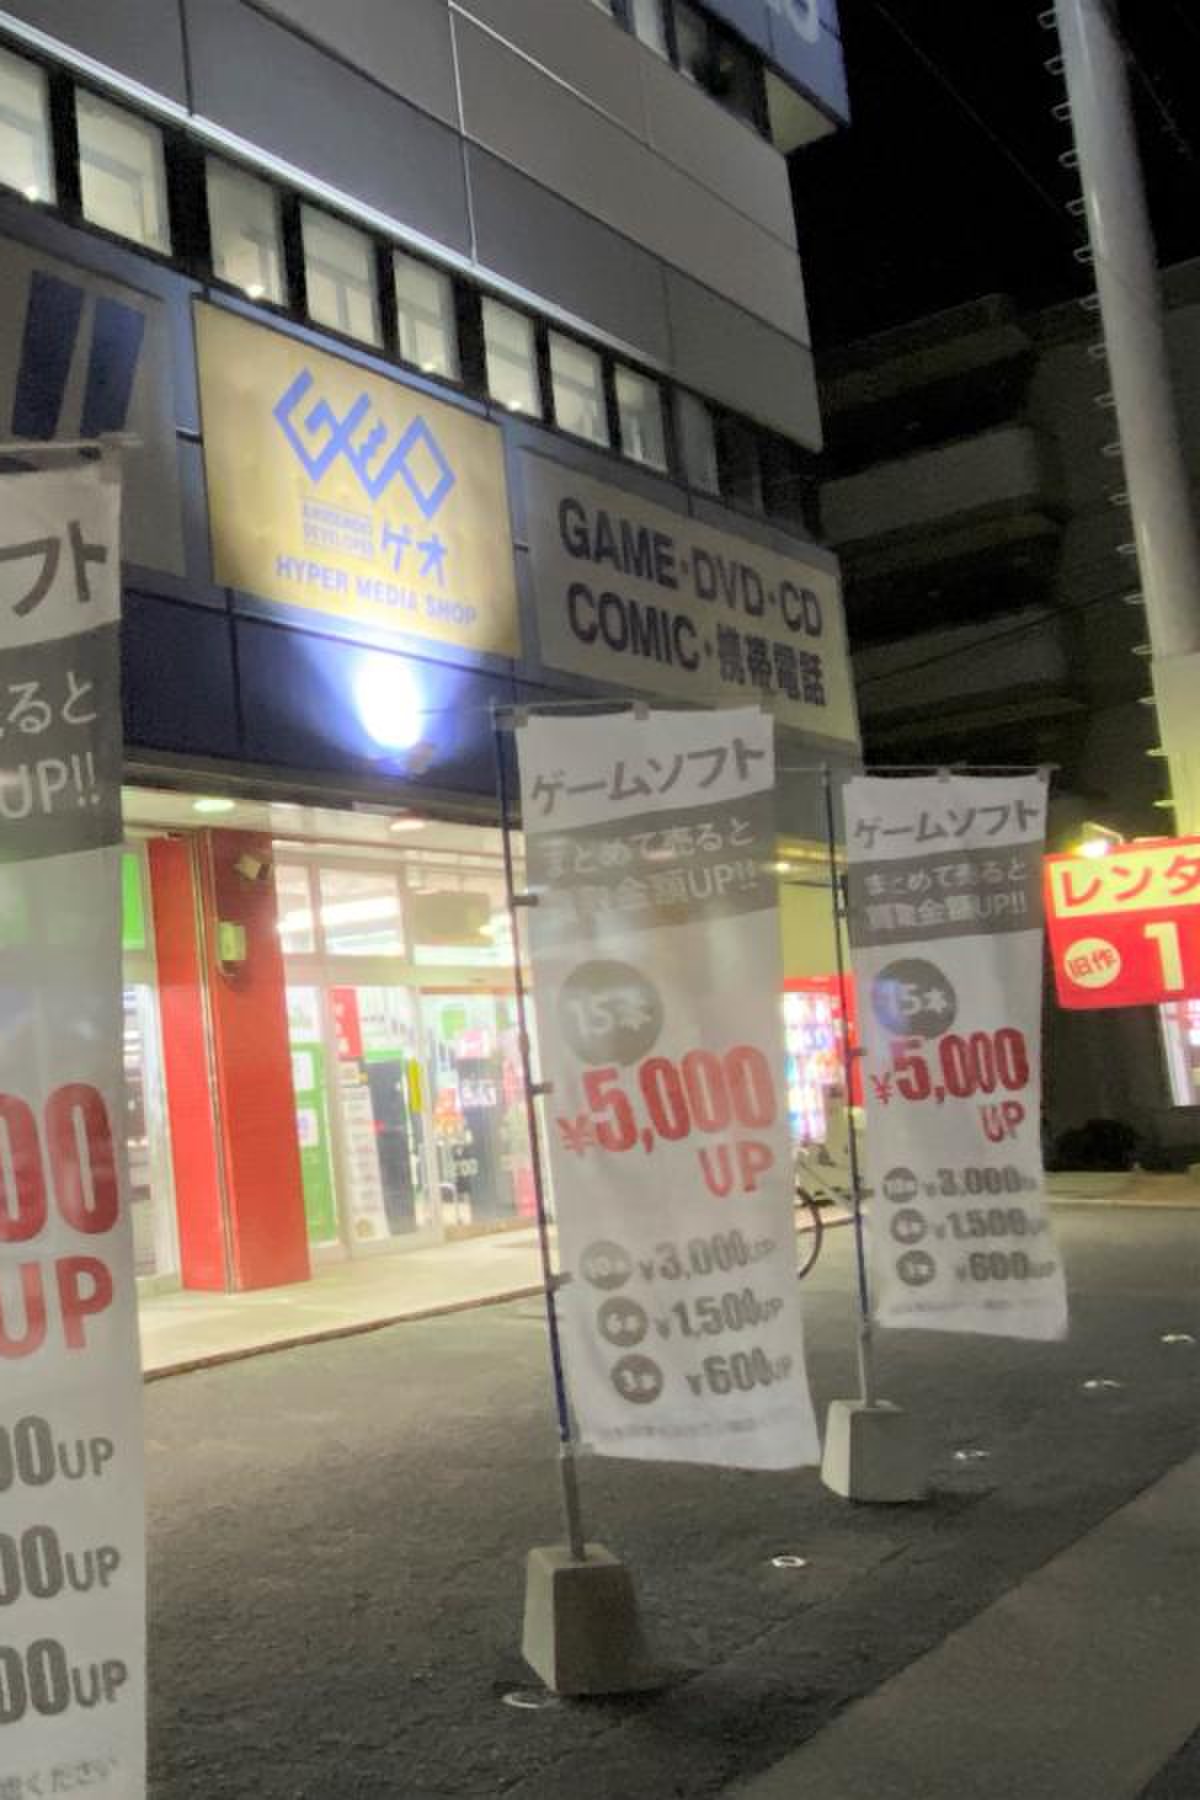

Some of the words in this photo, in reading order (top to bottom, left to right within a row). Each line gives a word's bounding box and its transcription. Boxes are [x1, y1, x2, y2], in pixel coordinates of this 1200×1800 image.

[379, 520, 448, 588] ゲオ
[275, 552, 348, 594] HYPER
[355, 573, 418, 611] MEDIA
[425, 591, 477, 625] SHOP
[531, 737, 766, 816] ゲームソフト
[853, 799, 1040, 849] ゲームソフト
[1070, 947, 1117, 978] 旧作
[980, 1099, 1026, 1144] UP
[698, 1140, 775, 1198] UP
